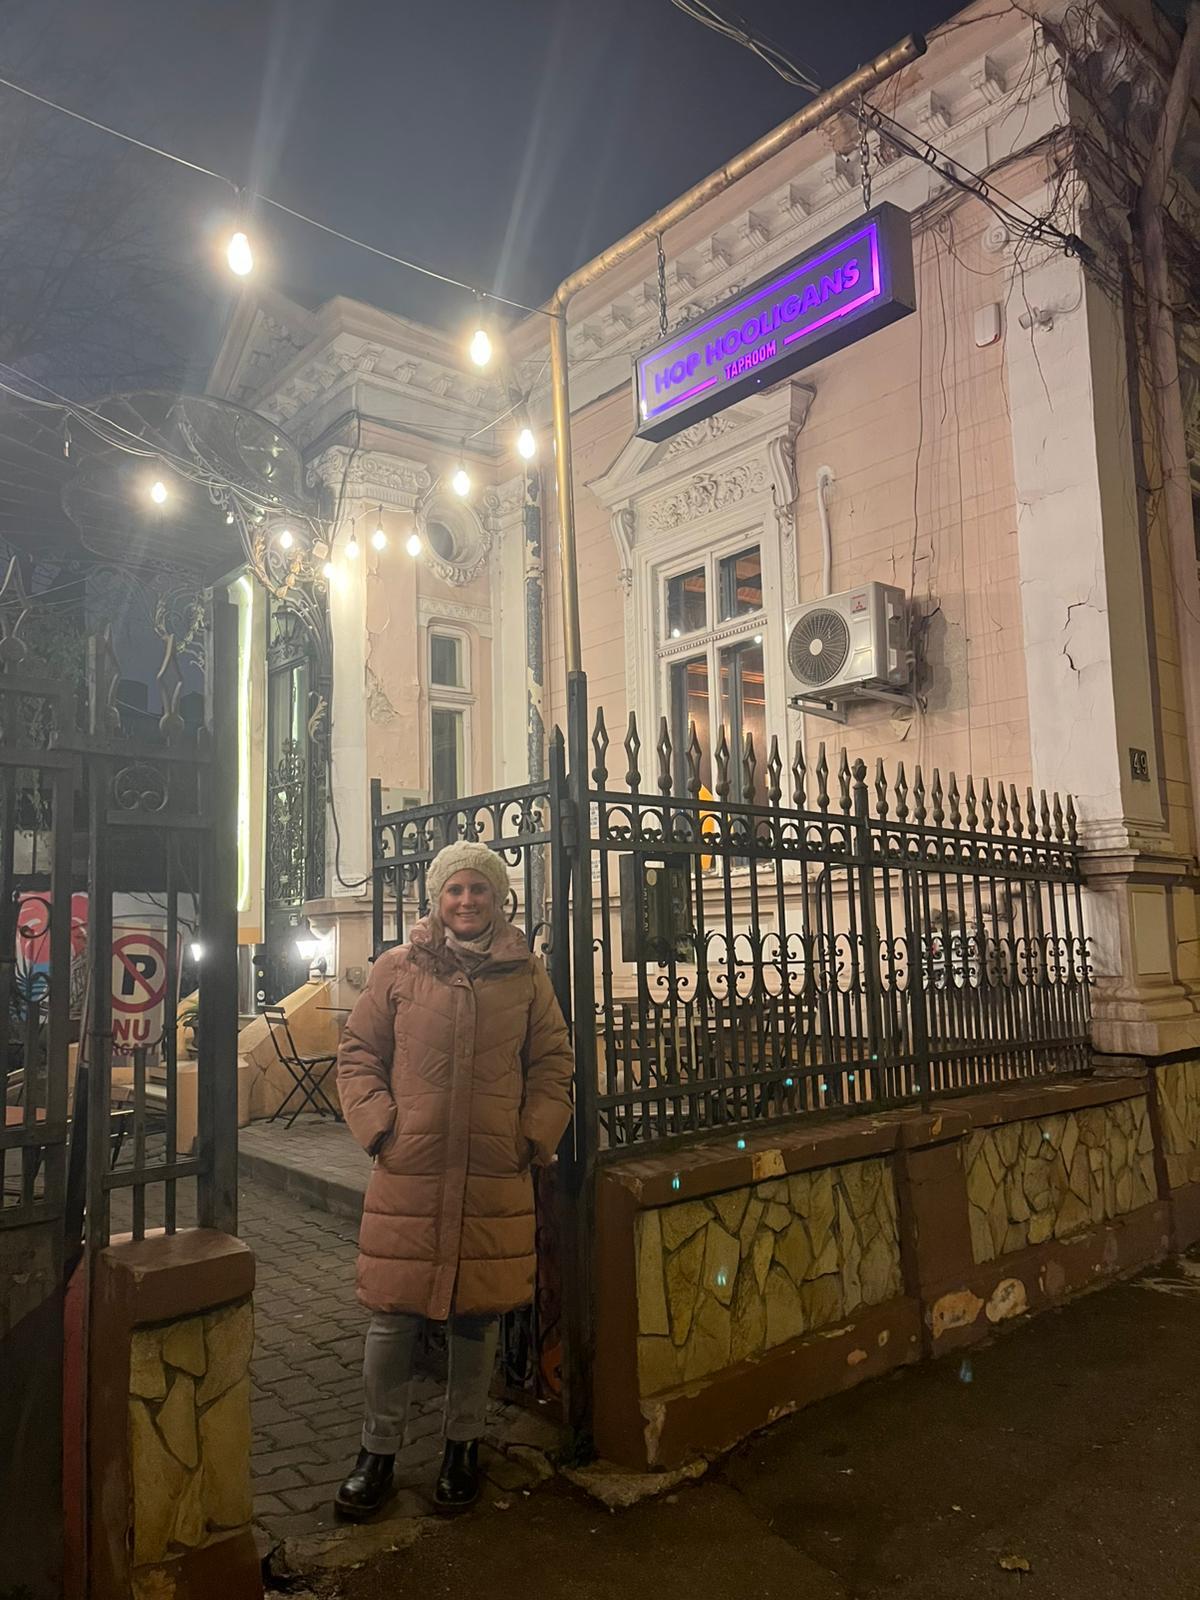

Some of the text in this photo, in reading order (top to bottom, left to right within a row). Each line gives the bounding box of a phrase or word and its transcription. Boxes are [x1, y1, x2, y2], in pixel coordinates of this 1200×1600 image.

[654, 259, 860, 394] HOP HOOLIGANS
[724, 339, 777, 380] TAPROOM
[1133, 752, 1147, 775] 49
[112, 1018, 150, 1041] NU
